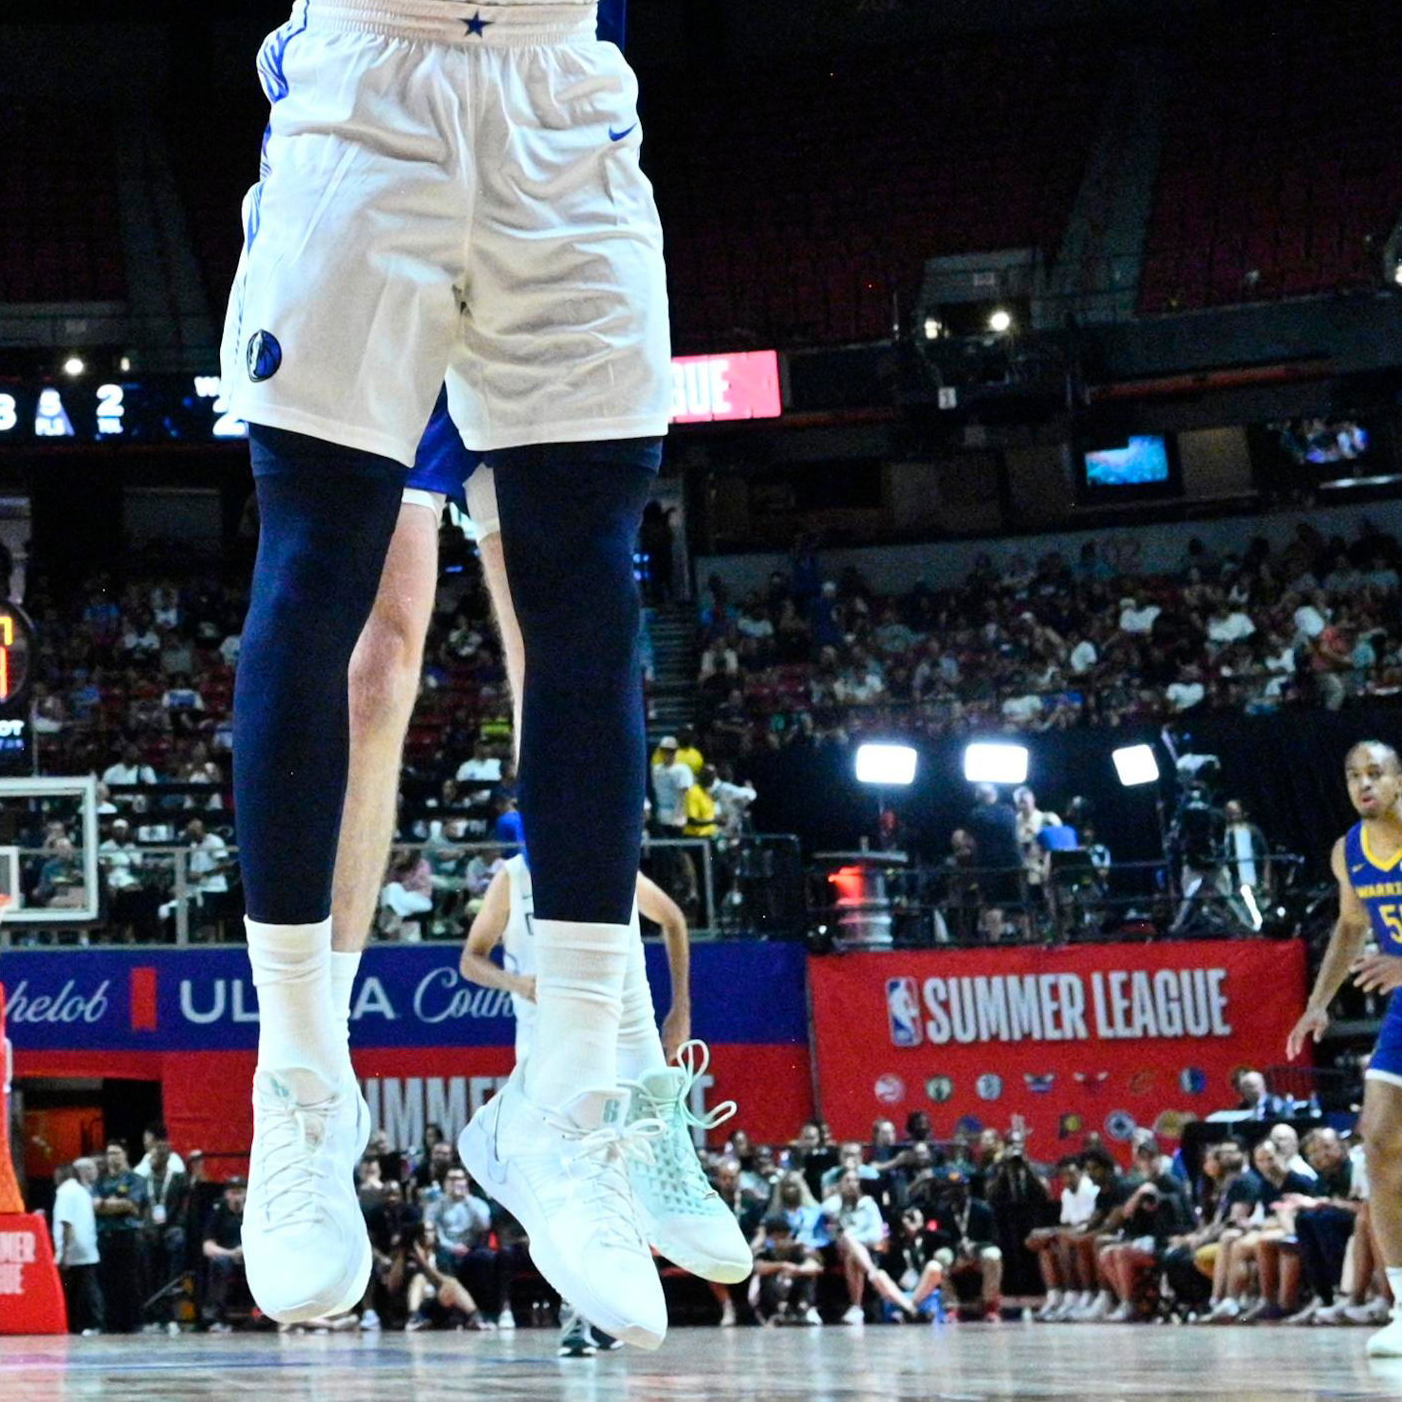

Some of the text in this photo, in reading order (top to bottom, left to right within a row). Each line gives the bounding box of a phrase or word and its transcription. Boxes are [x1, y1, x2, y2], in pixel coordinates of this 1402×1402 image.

[96, 384, 125, 417] 2
[179, 976, 399, 1024] ULA
[923, 967, 1232, 1045] SUMMER LEAGUE
